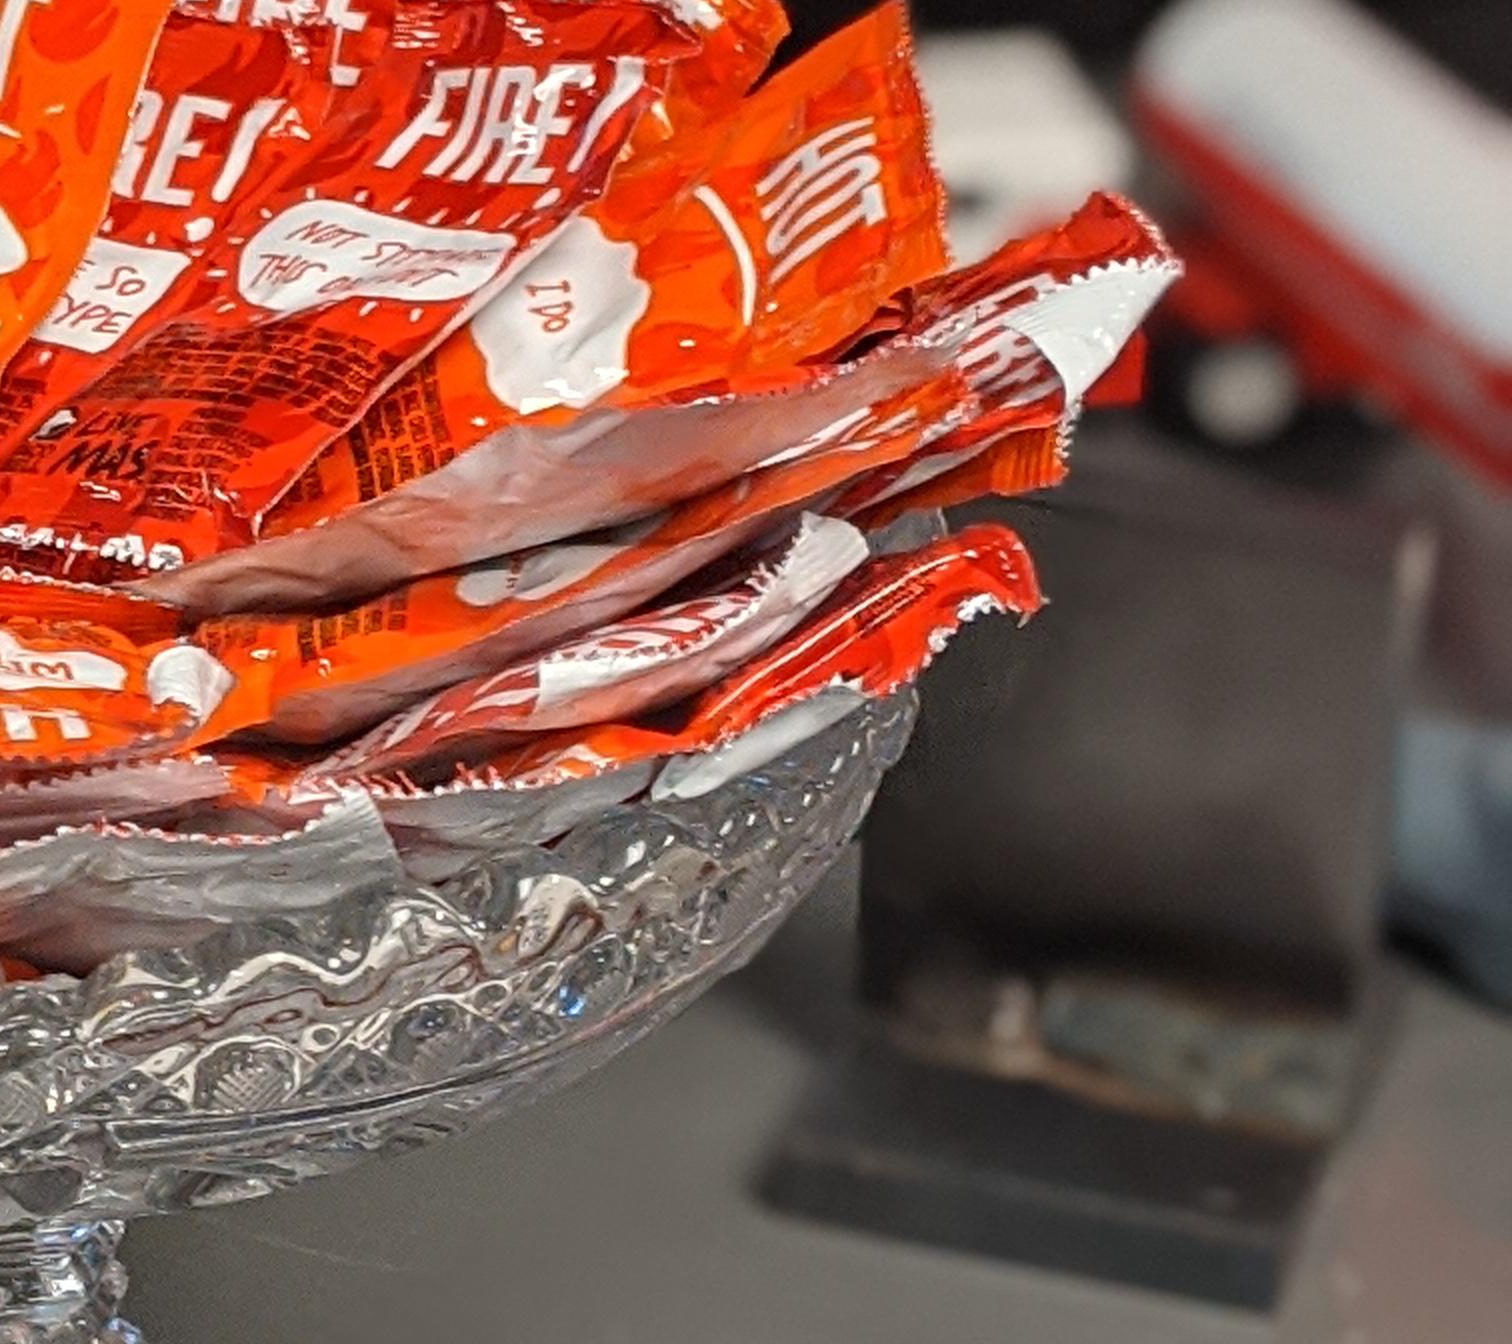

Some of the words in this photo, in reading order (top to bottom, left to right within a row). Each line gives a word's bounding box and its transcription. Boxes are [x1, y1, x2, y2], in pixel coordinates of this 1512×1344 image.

[375, 55, 644, 210] FIRE!
[756, 116, 886, 285] HOT
[284, 219, 369, 248] NOT
[96, 265, 147, 297] SO
[248, 252, 327, 288] THIS
[525, 279, 570, 296] I
[54, 298, 133, 336] YPE
[528, 301, 571, 334] DO
